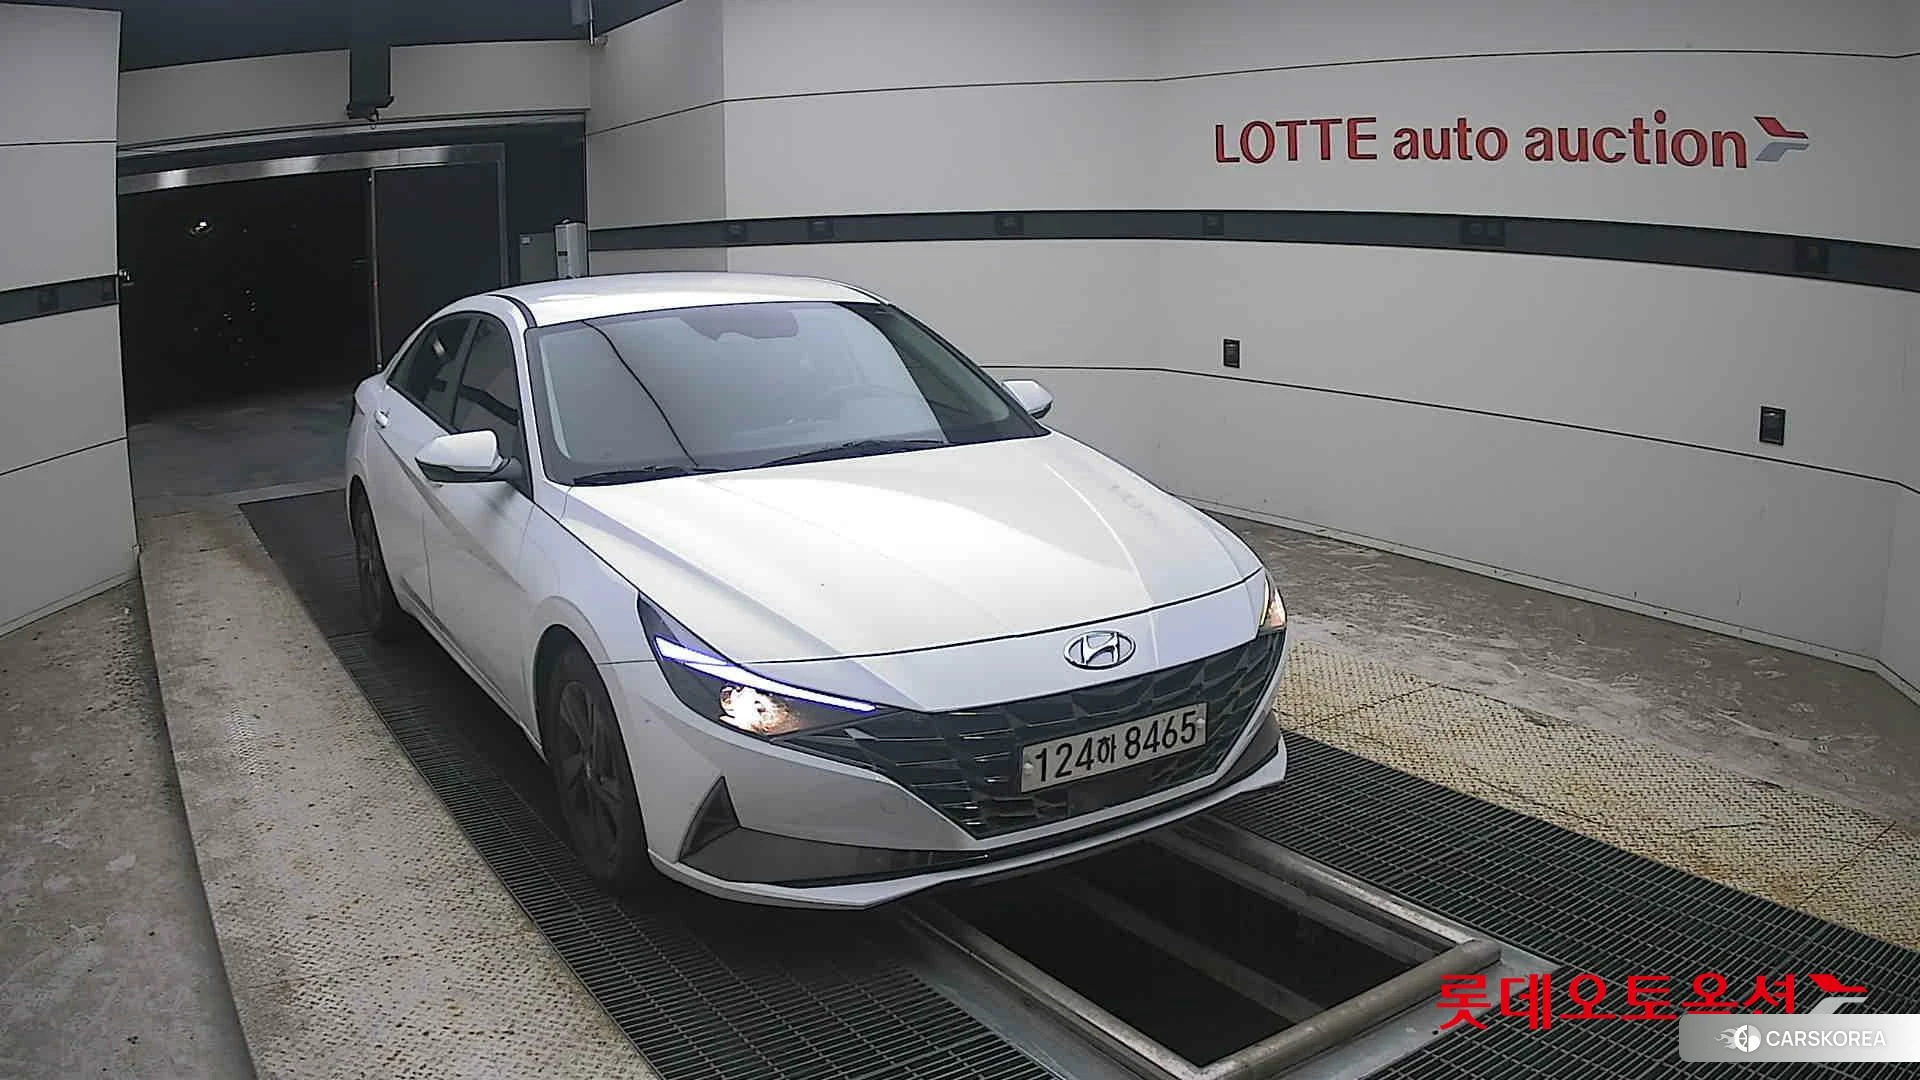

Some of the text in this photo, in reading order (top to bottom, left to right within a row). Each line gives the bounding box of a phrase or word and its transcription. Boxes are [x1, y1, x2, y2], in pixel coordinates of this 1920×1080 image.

[1215, 110, 1747, 168] LOTTE auto auction
